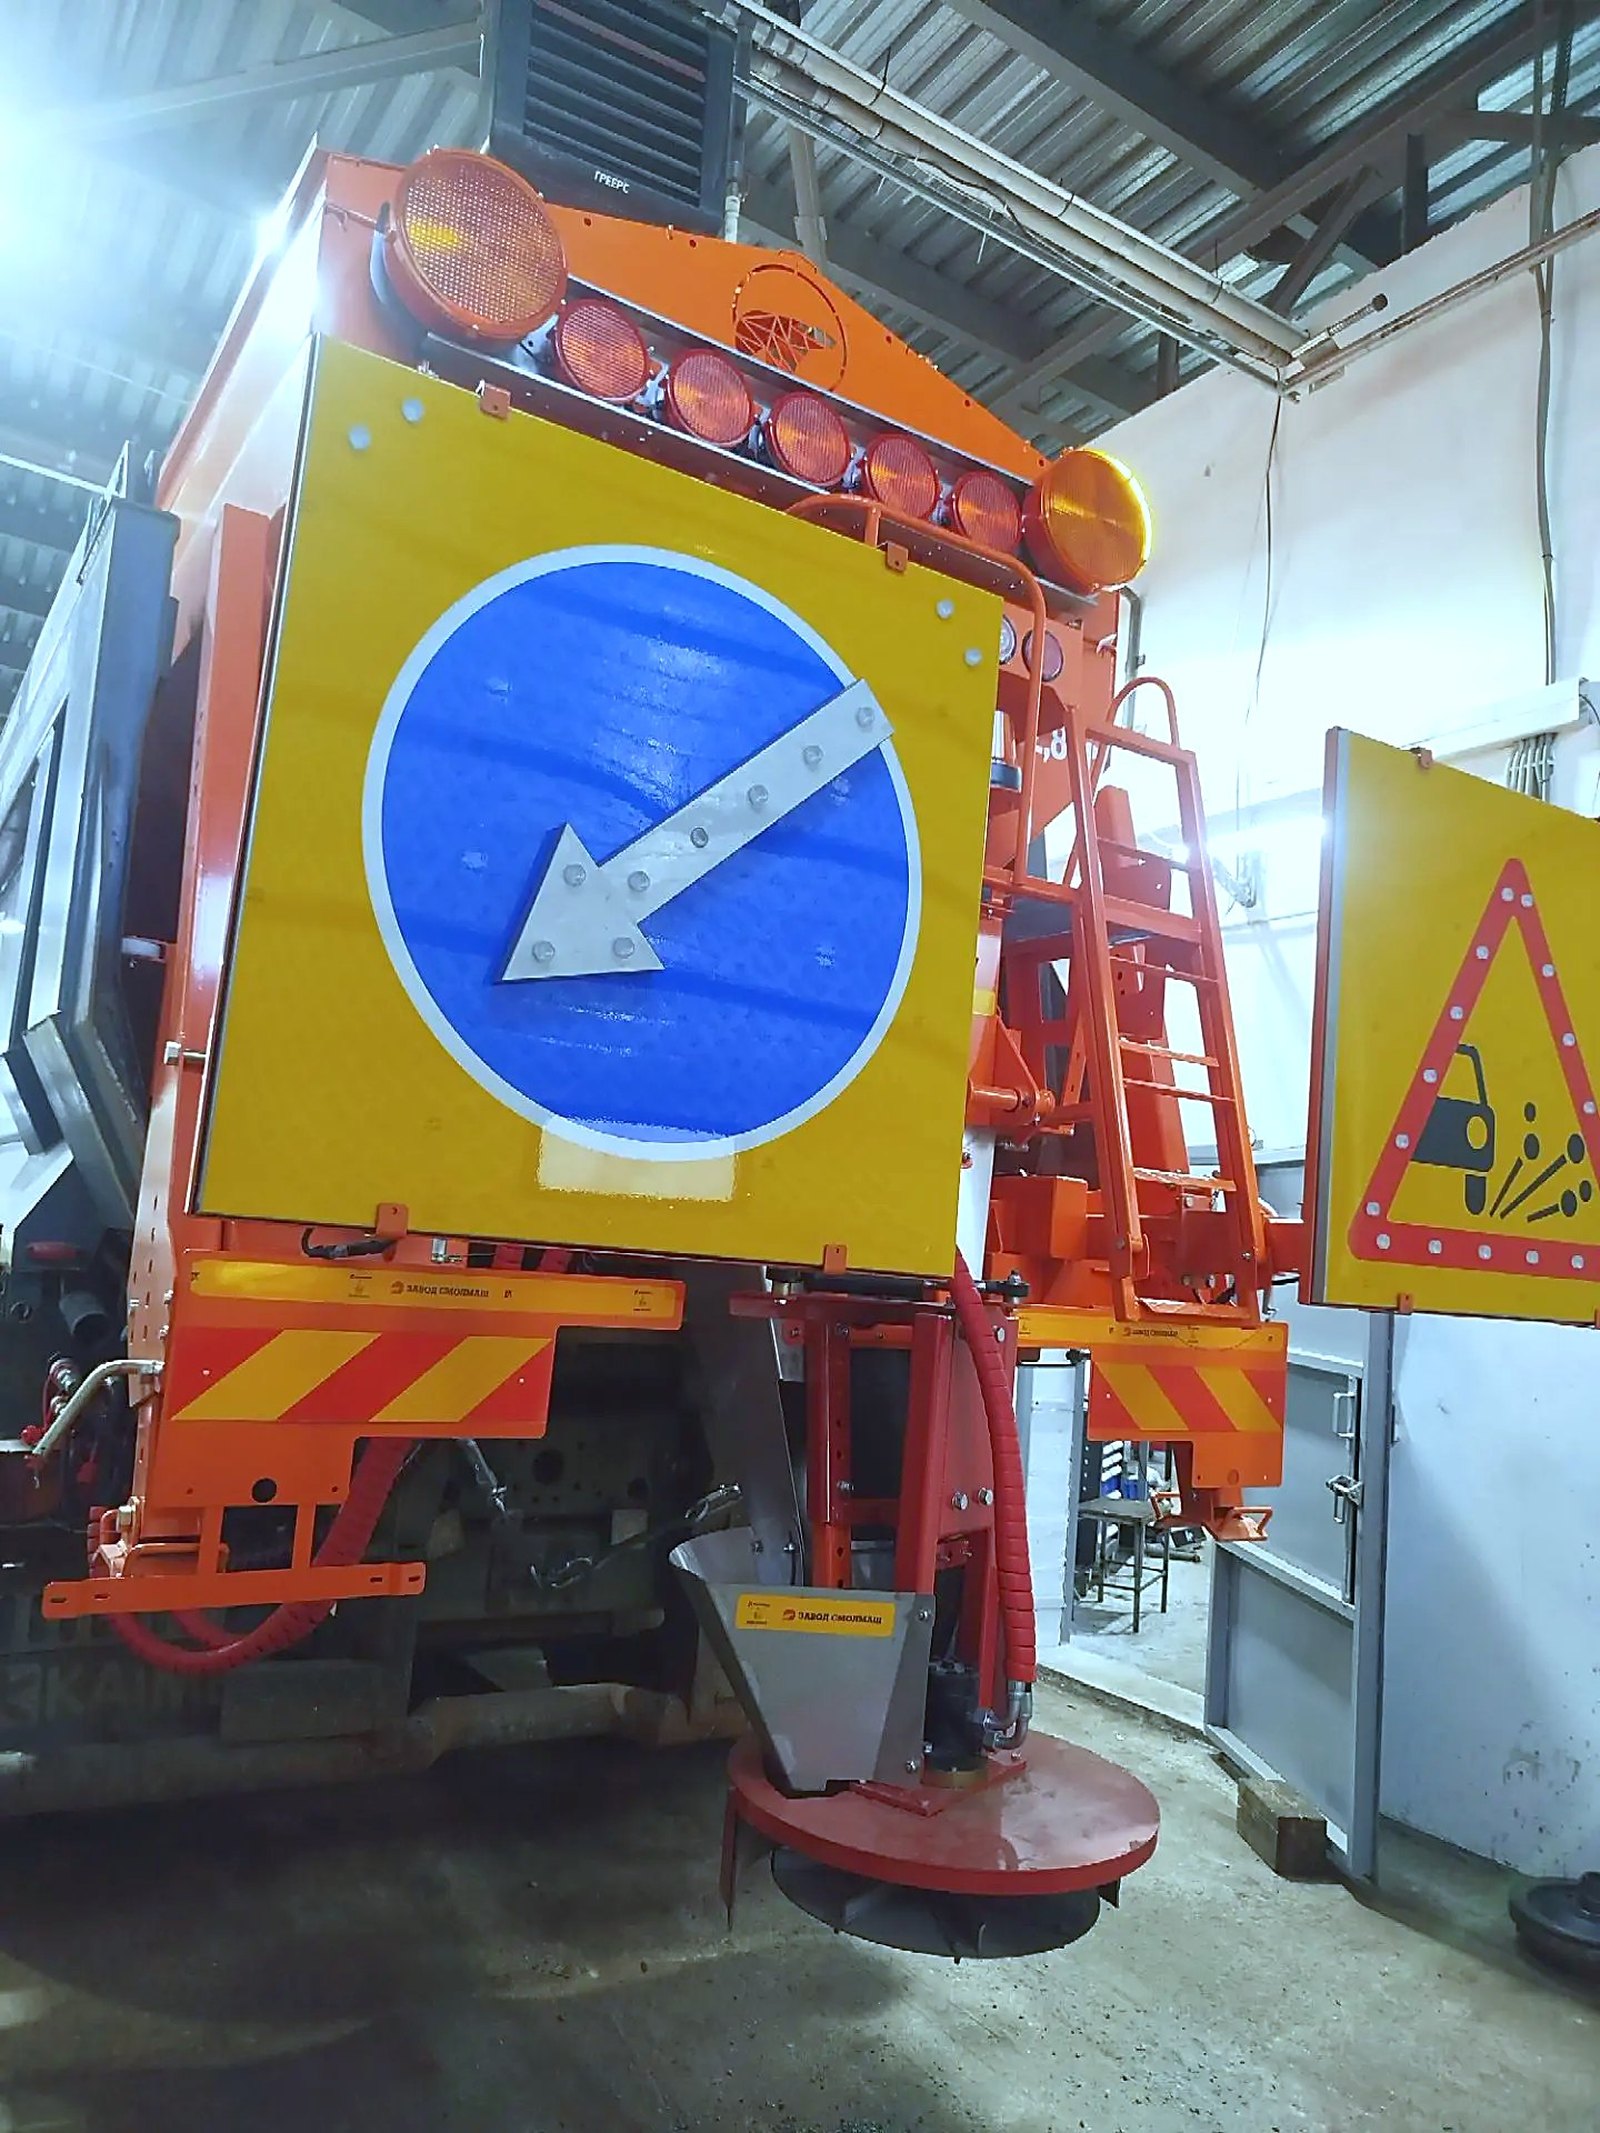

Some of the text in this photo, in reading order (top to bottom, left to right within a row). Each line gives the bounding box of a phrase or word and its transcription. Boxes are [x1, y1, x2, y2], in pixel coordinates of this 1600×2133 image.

[594, 170, 630, 194] ГРЕЕРС
[406, 1284, 437, 1294] ЗАВОД
[798, 1611, 882, 1624] ЗАВОД СМОЛМАШ
